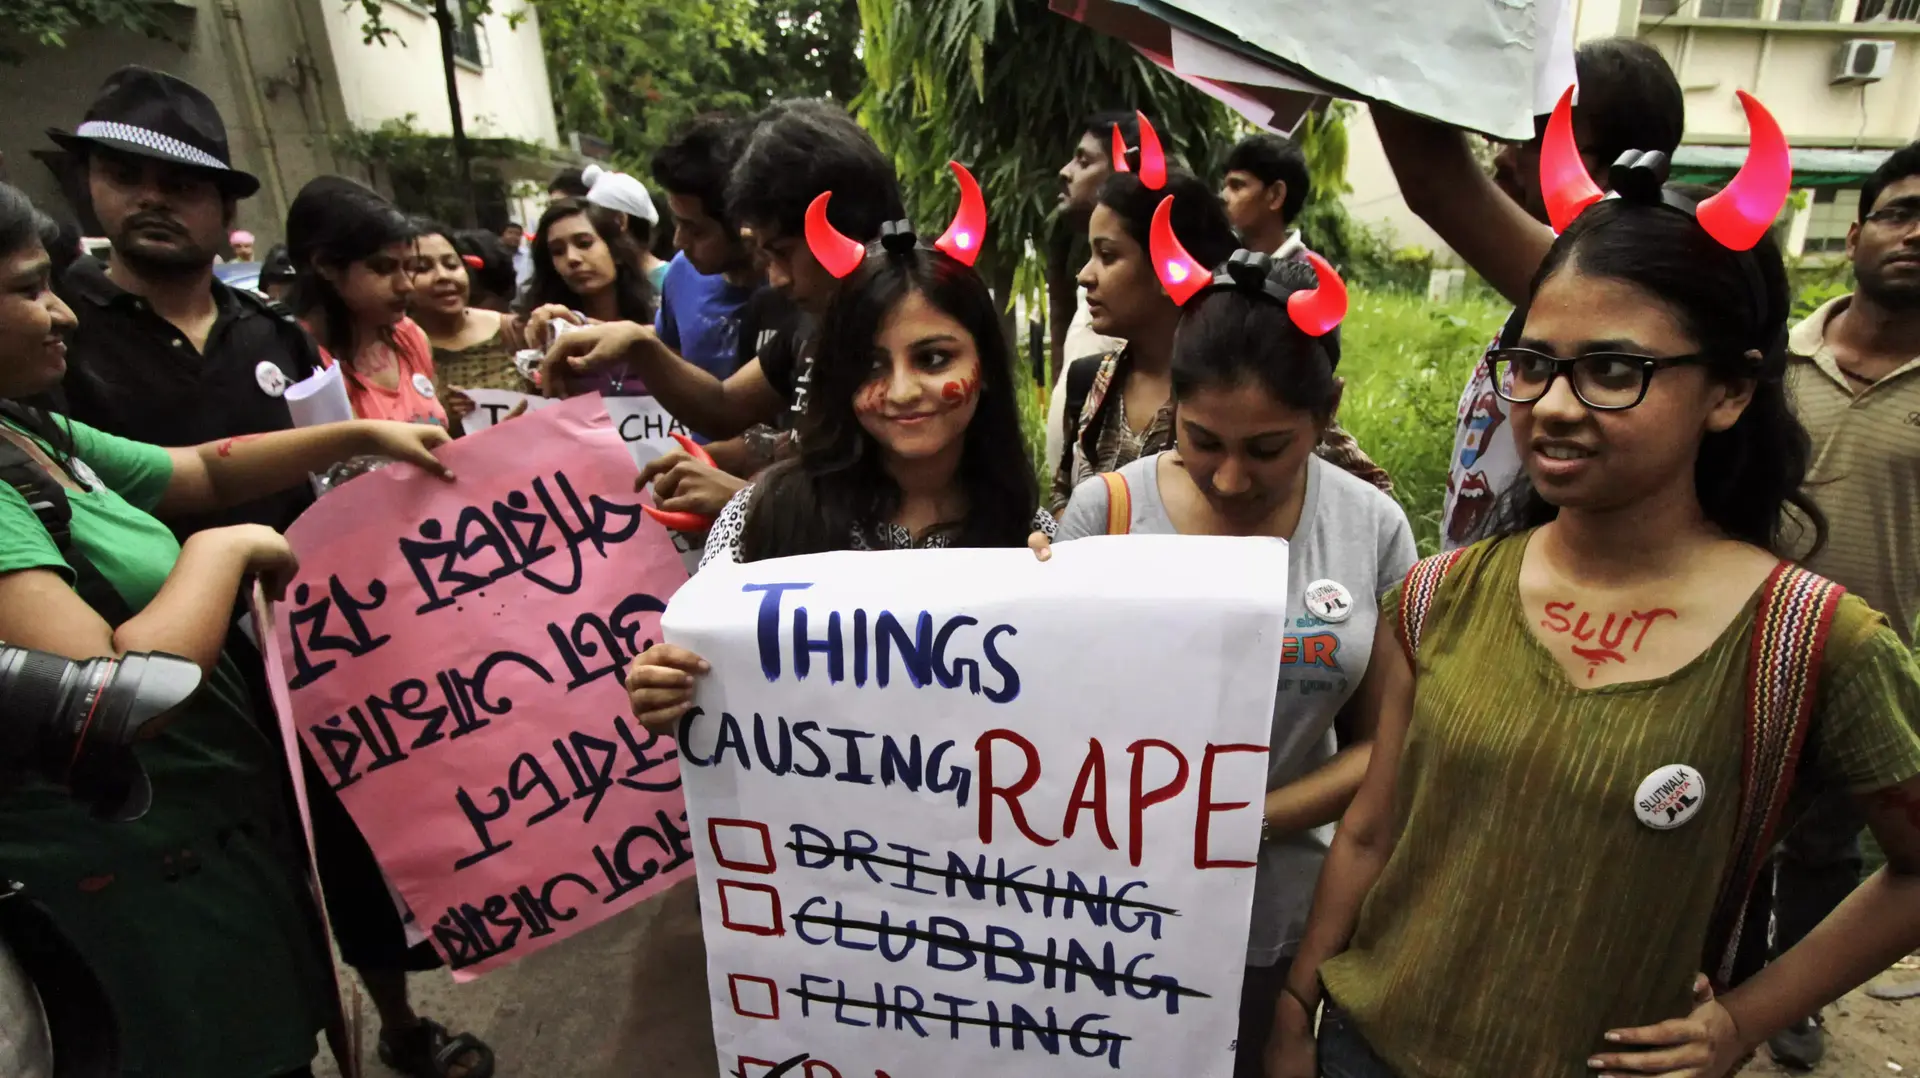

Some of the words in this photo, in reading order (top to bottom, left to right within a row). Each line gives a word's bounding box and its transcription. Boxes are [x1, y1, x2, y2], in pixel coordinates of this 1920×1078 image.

[619, 414, 693, 442] CHA
[742, 581, 1021, 704] THINGS
[1281, 634, 1338, 668] ER
[1541, 601, 1678, 653] SLUT
[677, 705, 971, 808] CAUSING
[974, 728, 1271, 870] RAPE
[1639, 769, 1689, 812] SLUTWALK
[1652, 781, 1691, 815] KOLKATA
[791, 823, 1163, 940] DRINKING
[795, 896, 1180, 1014] CLUBBING
[800, 974, 1123, 1069] FLIRTING
